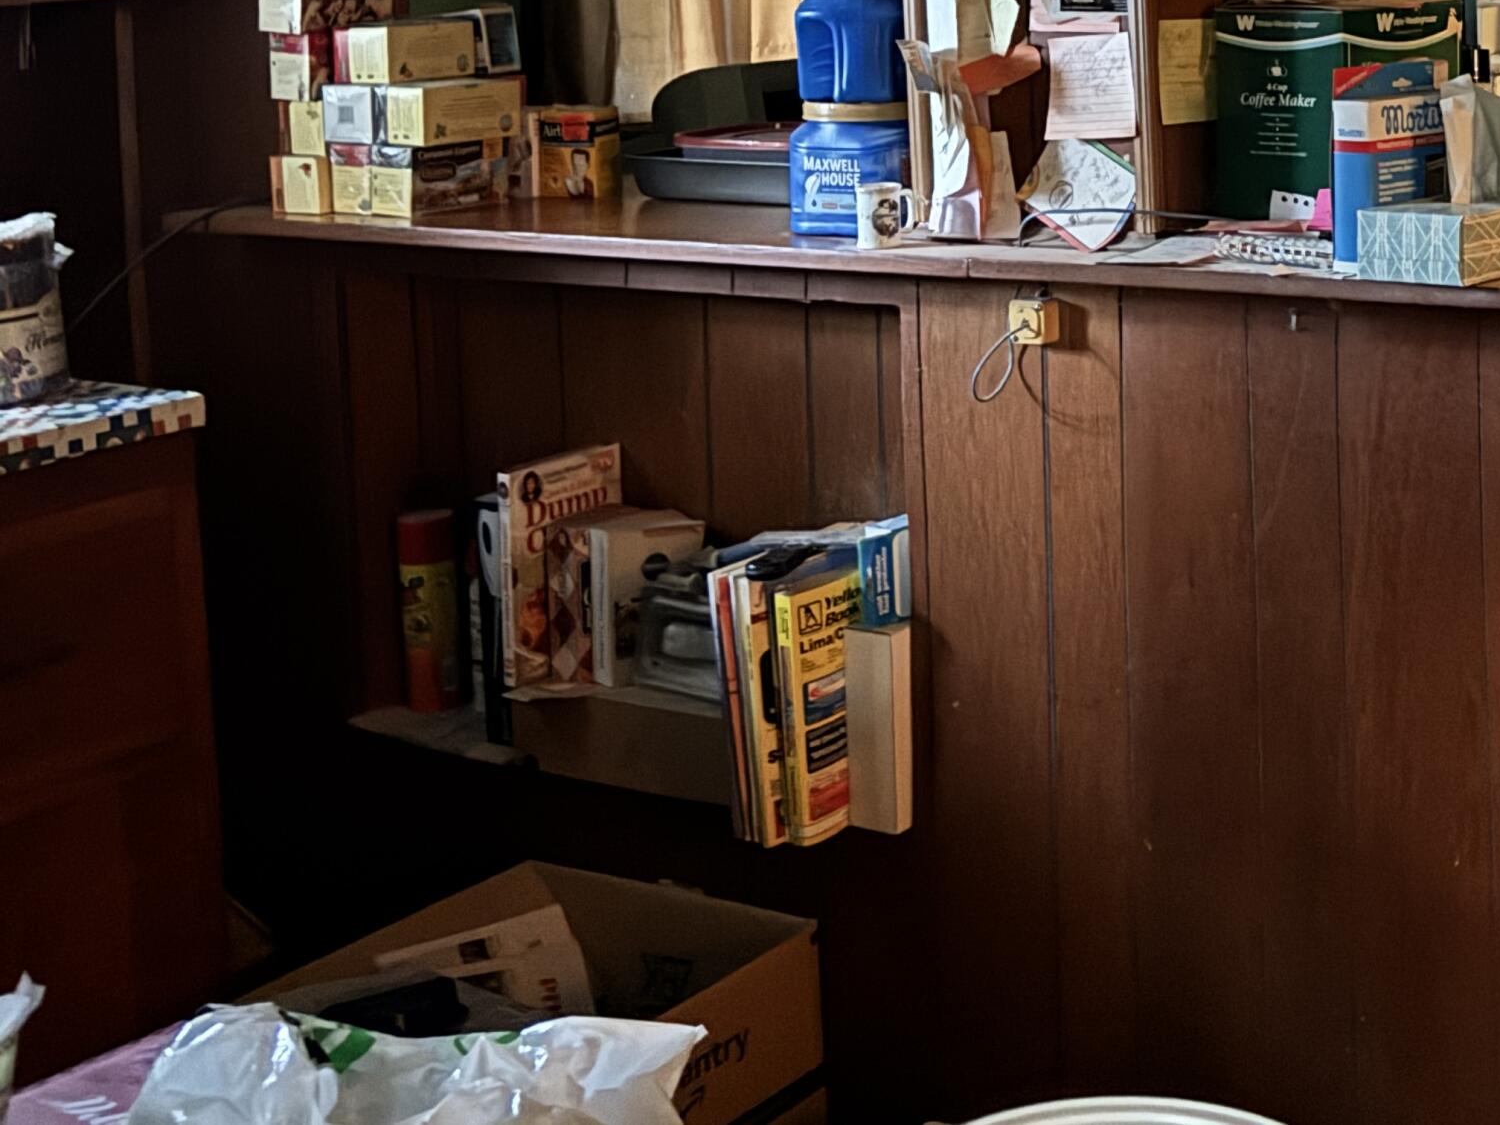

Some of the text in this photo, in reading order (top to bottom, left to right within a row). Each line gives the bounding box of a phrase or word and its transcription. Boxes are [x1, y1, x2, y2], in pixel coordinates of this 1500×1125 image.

[1240, 91, 1317, 108] Coffee Maker
[803, 155, 861, 173] MAXWELL
[821, 172, 862, 187] HOUSE
[526, 485, 608, 528] Dump
[824, 586, 862, 611] Yello
[799, 634, 835, 655] Lima
